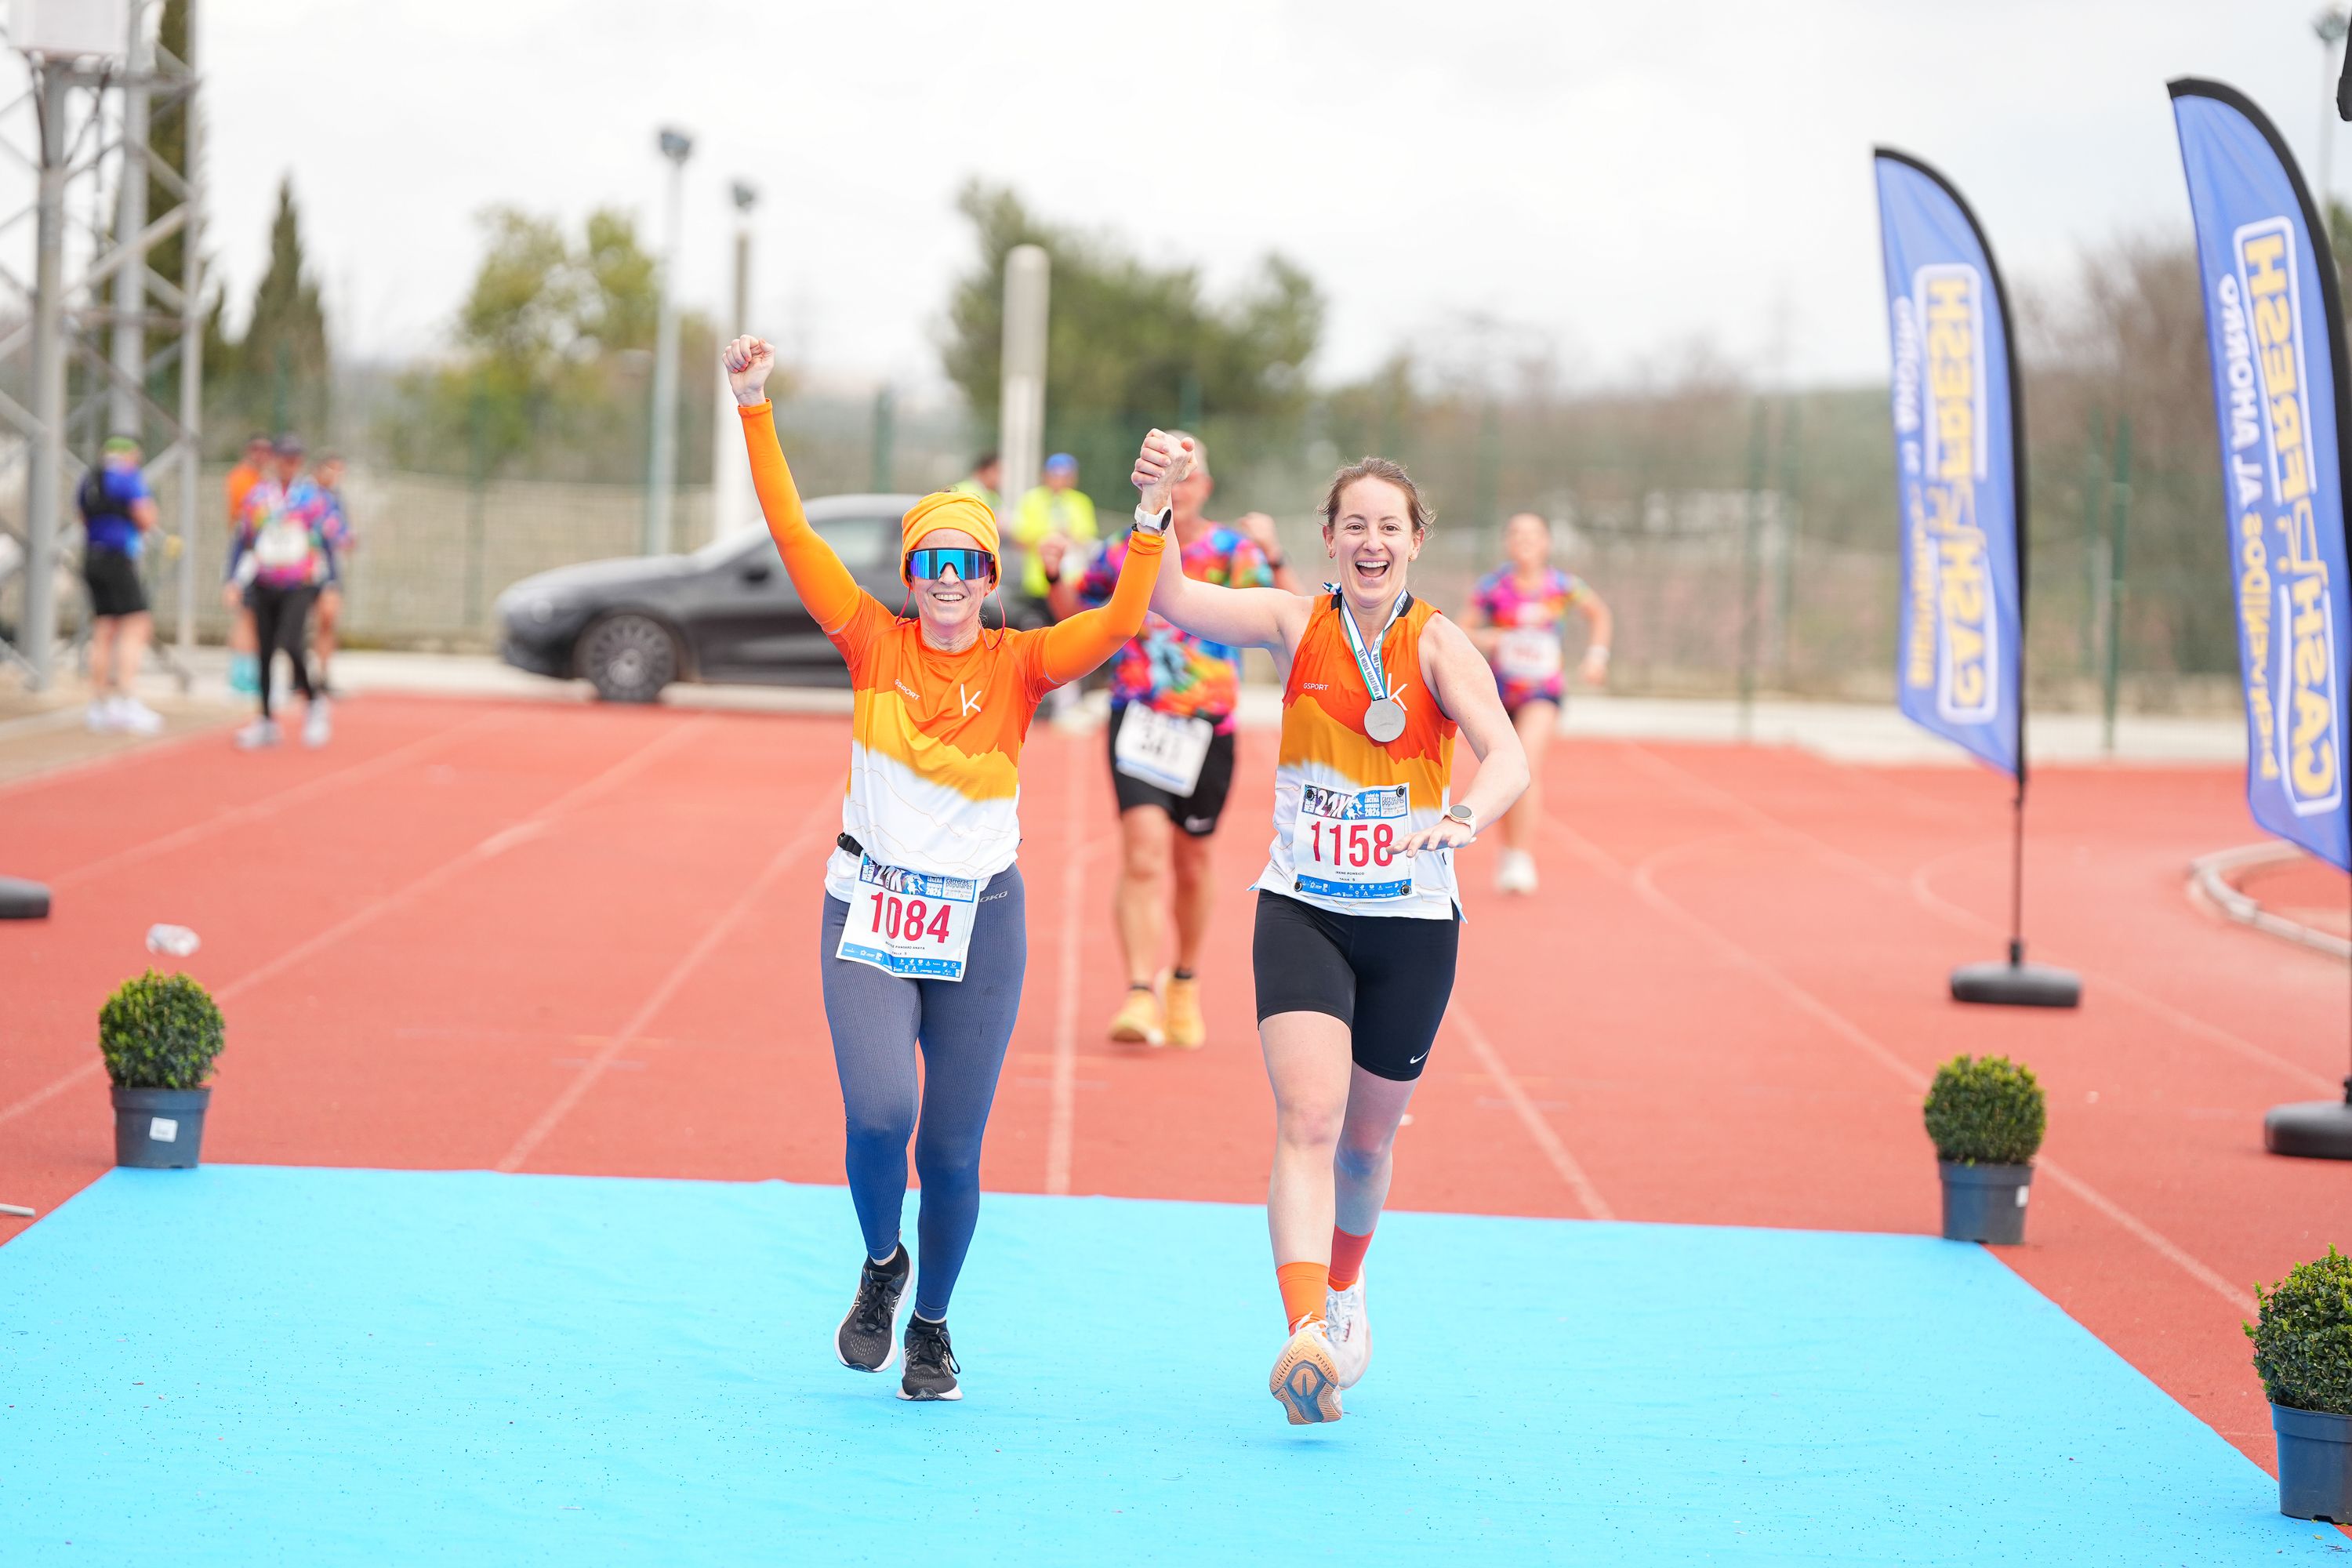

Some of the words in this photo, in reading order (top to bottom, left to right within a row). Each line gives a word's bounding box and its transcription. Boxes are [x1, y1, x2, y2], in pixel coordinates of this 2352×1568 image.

[1357, 648, 1366, 659] XII
[1360, 657, 1370, 672] MEDIA
[1303, 682, 1329, 691] GSPORT
[1311, 821, 1394, 868] 1158
[979, 891, 1008, 903] OKO
[870, 891, 952, 944] 1084
